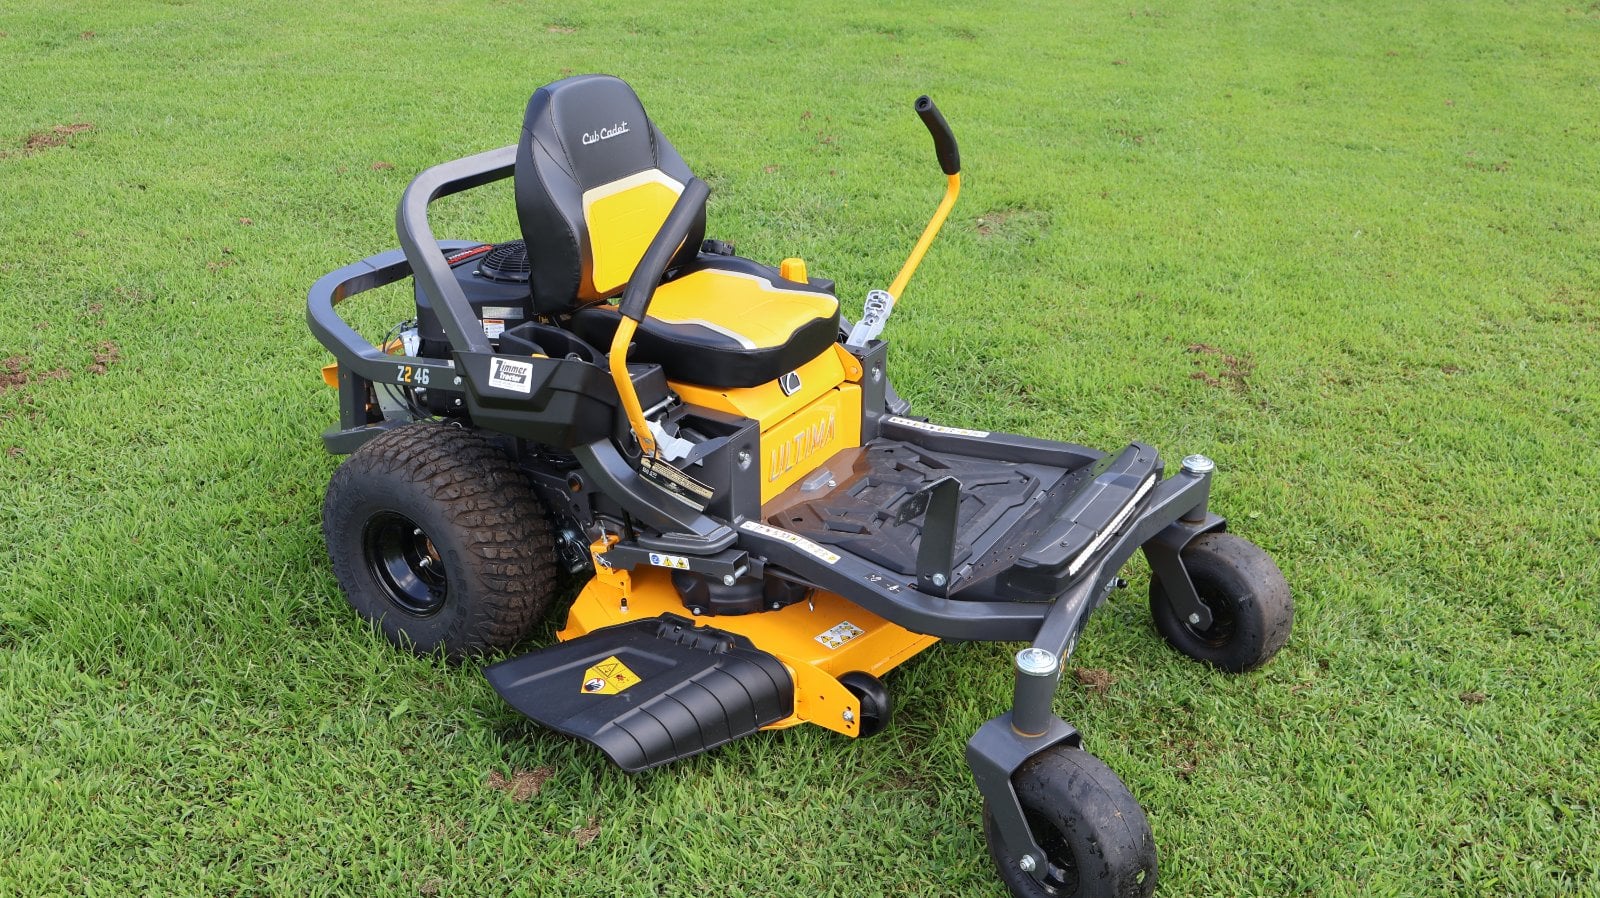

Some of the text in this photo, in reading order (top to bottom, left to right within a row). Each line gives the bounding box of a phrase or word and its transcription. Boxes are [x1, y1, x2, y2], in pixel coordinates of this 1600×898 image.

[582, 121, 630, 145] Cub Cadet
[397, 365, 430, 385] Z2 46
[494, 360, 527, 376] Zimmer
[768, 412, 835, 482] ULTIMA
